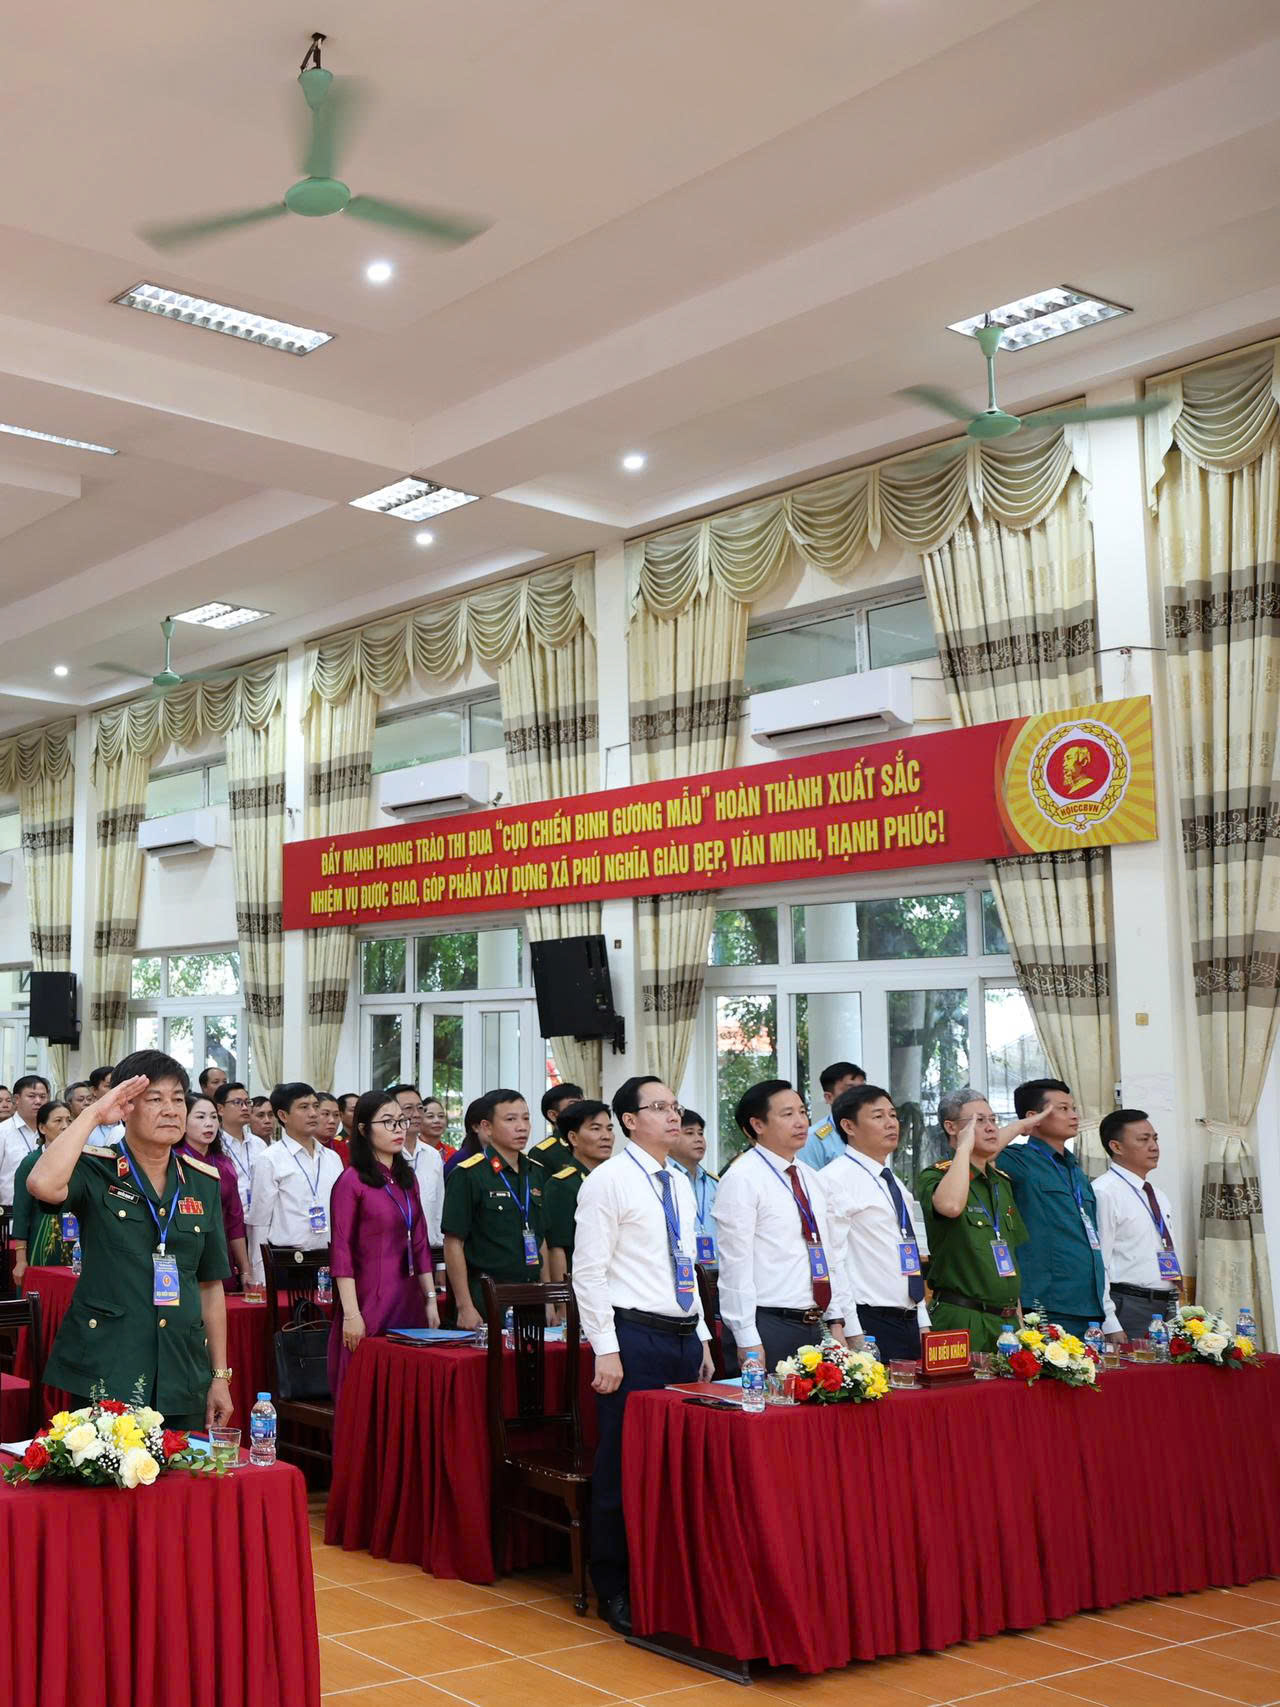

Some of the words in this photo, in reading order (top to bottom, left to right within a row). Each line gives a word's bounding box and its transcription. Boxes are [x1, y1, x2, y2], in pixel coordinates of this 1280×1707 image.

[311, 885, 342, 917] NHIỆM
[345, 886, 359, 915] VỤ
[361, 881, 389, 912] ĐƯỢC
[392, 879, 420, 906] GIAO,
[423, 872, 446, 903] GÓP
[449, 864, 481, 899] PHẦN
[484, 864, 508, 896] XÂY
[512, 863, 547, 897] DỰNG
[551, 855, 569, 888] XÃ
[573, 851, 600, 885] PHÚ
[605, 845, 650, 882] NGHĨA
[653, 840, 689, 876] GIÀU
[693, 840, 727, 877] ĐẸP,
[731, 830, 765, 867] VĂN
[770, 827, 822, 862] MINH,
[827, 819, 879, 861] HẠNH
[884, 805, 945, 849] PHÚC!
[322, 843, 340, 876] ĐẨY
[344, 847, 374, 877] MẠNH
[377, 841, 413, 869] PHONG
[416, 832, 444, 863] TRÀO
[448, 833, 466, 859] THI
[469, 829, 493, 856] ĐUA
[531, 809, 571, 848] CHIẾN
[575, 810, 609, 841] BINH
[612, 801, 662, 836] GƯƠNG
[715, 782, 761, 821] HOÀN
[764, 774, 823, 813] THÀNH
[828, 757, 875, 804] XUẤT
[881, 750, 920, 797] SẮC
